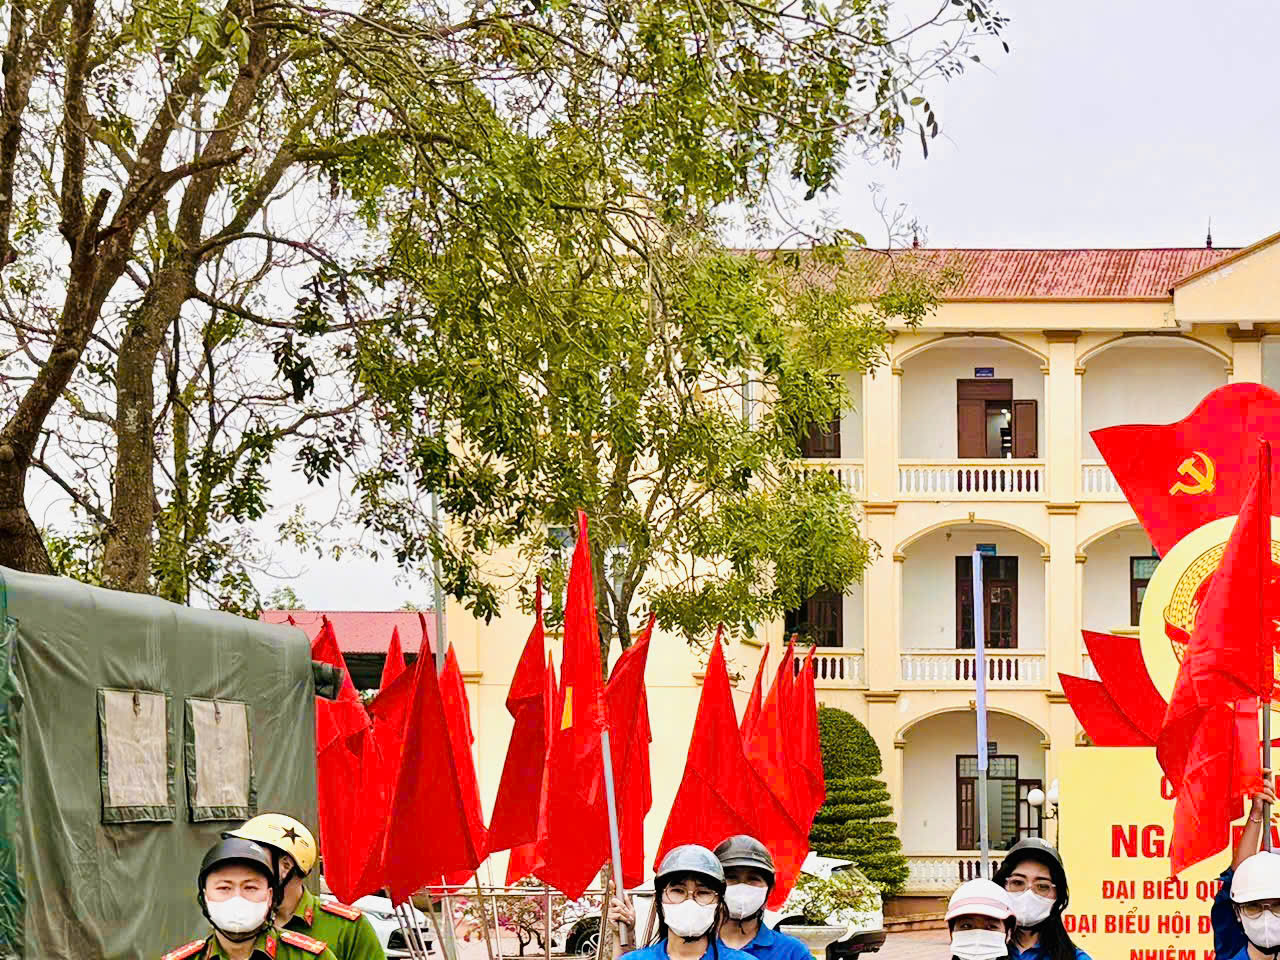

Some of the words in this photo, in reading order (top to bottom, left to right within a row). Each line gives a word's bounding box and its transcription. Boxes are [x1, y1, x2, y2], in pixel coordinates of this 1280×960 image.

[1111, 825, 1174, 858] NG
[1102, 880, 1135, 904] ĐẠI
[1143, 876, 1188, 900] BIỂU
[1064, 914, 1097, 938] ĐẠI
[1104, 906, 1150, 934] BIỂU
[1157, 911, 1190, 939] HỘI
